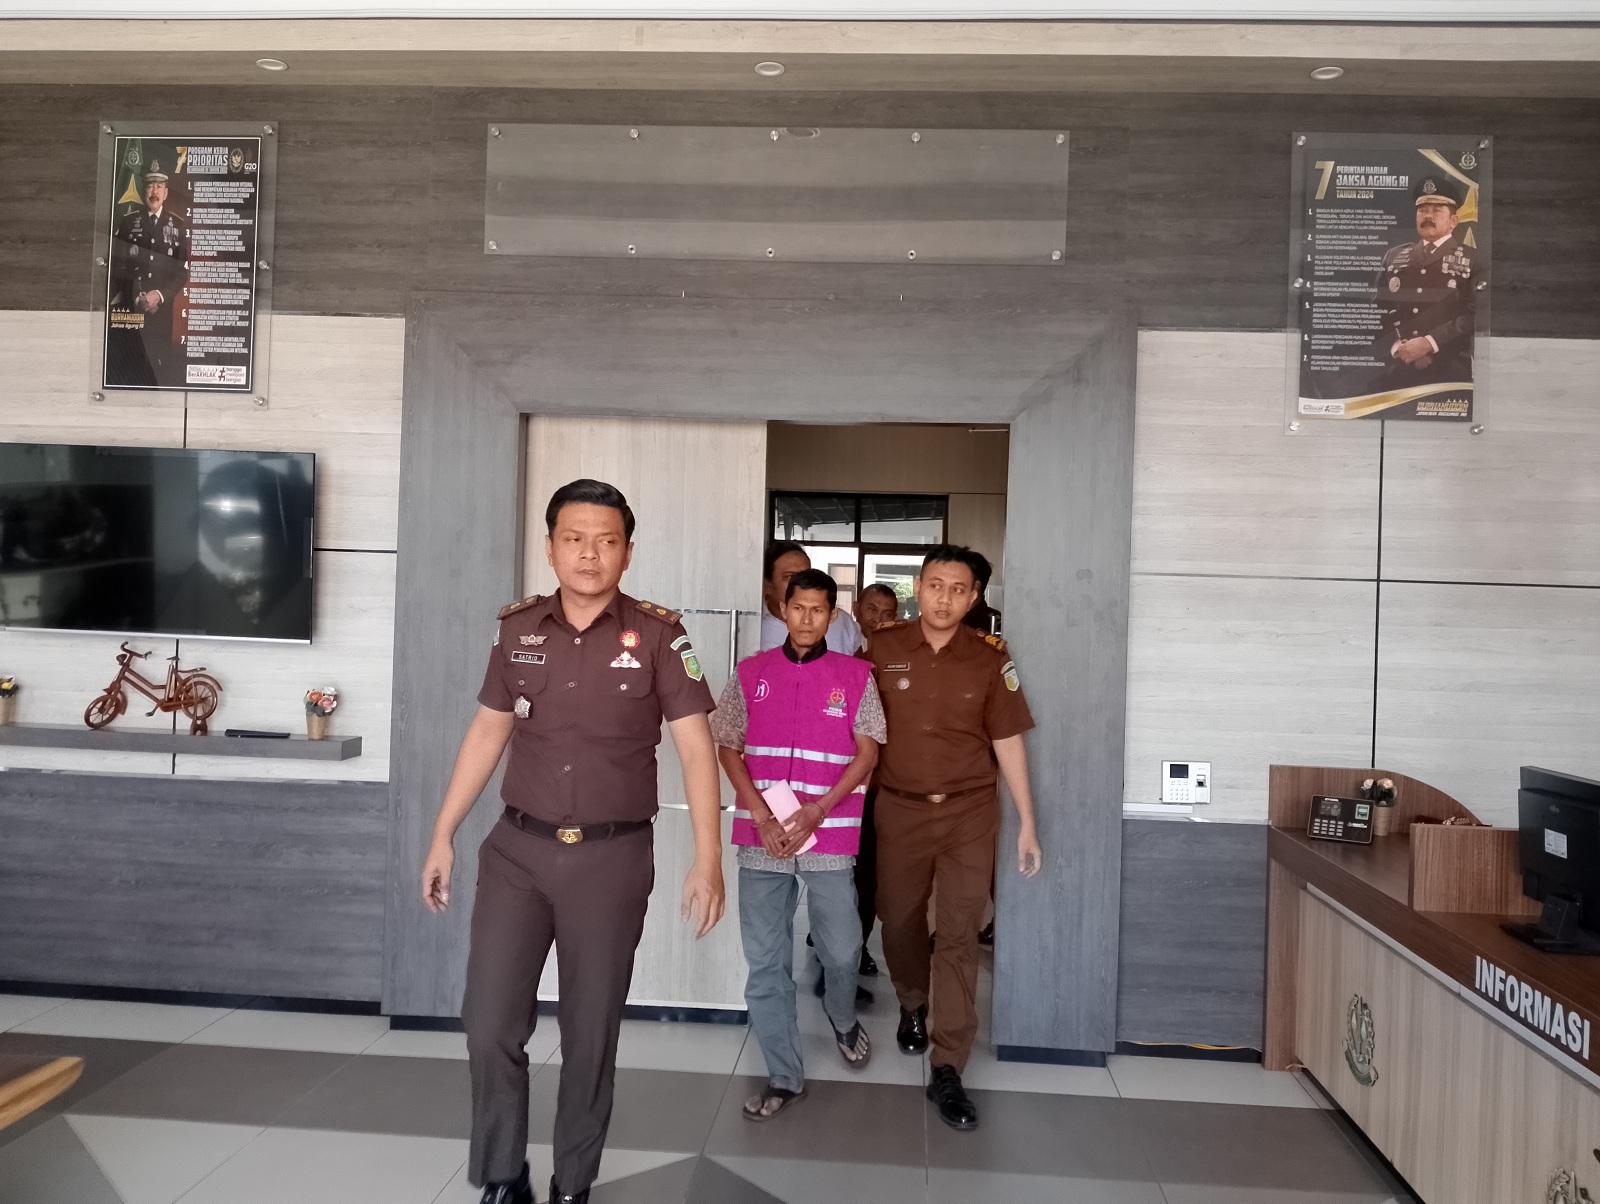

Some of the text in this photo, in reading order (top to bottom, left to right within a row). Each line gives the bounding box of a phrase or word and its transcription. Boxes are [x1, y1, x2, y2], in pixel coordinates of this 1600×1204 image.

[175, 147, 187, 173] 7
[187, 155, 228, 166] PRIORITAS
[1336, 166, 1365, 174] PERINTAH
[1315, 161, 1335, 199] 7
[1336, 175, 1408, 187] JAKSA AGUNG RI
[1336, 190, 1374, 199] TAHUN 2024
[1475, 955, 1590, 1060] INFORMASI
